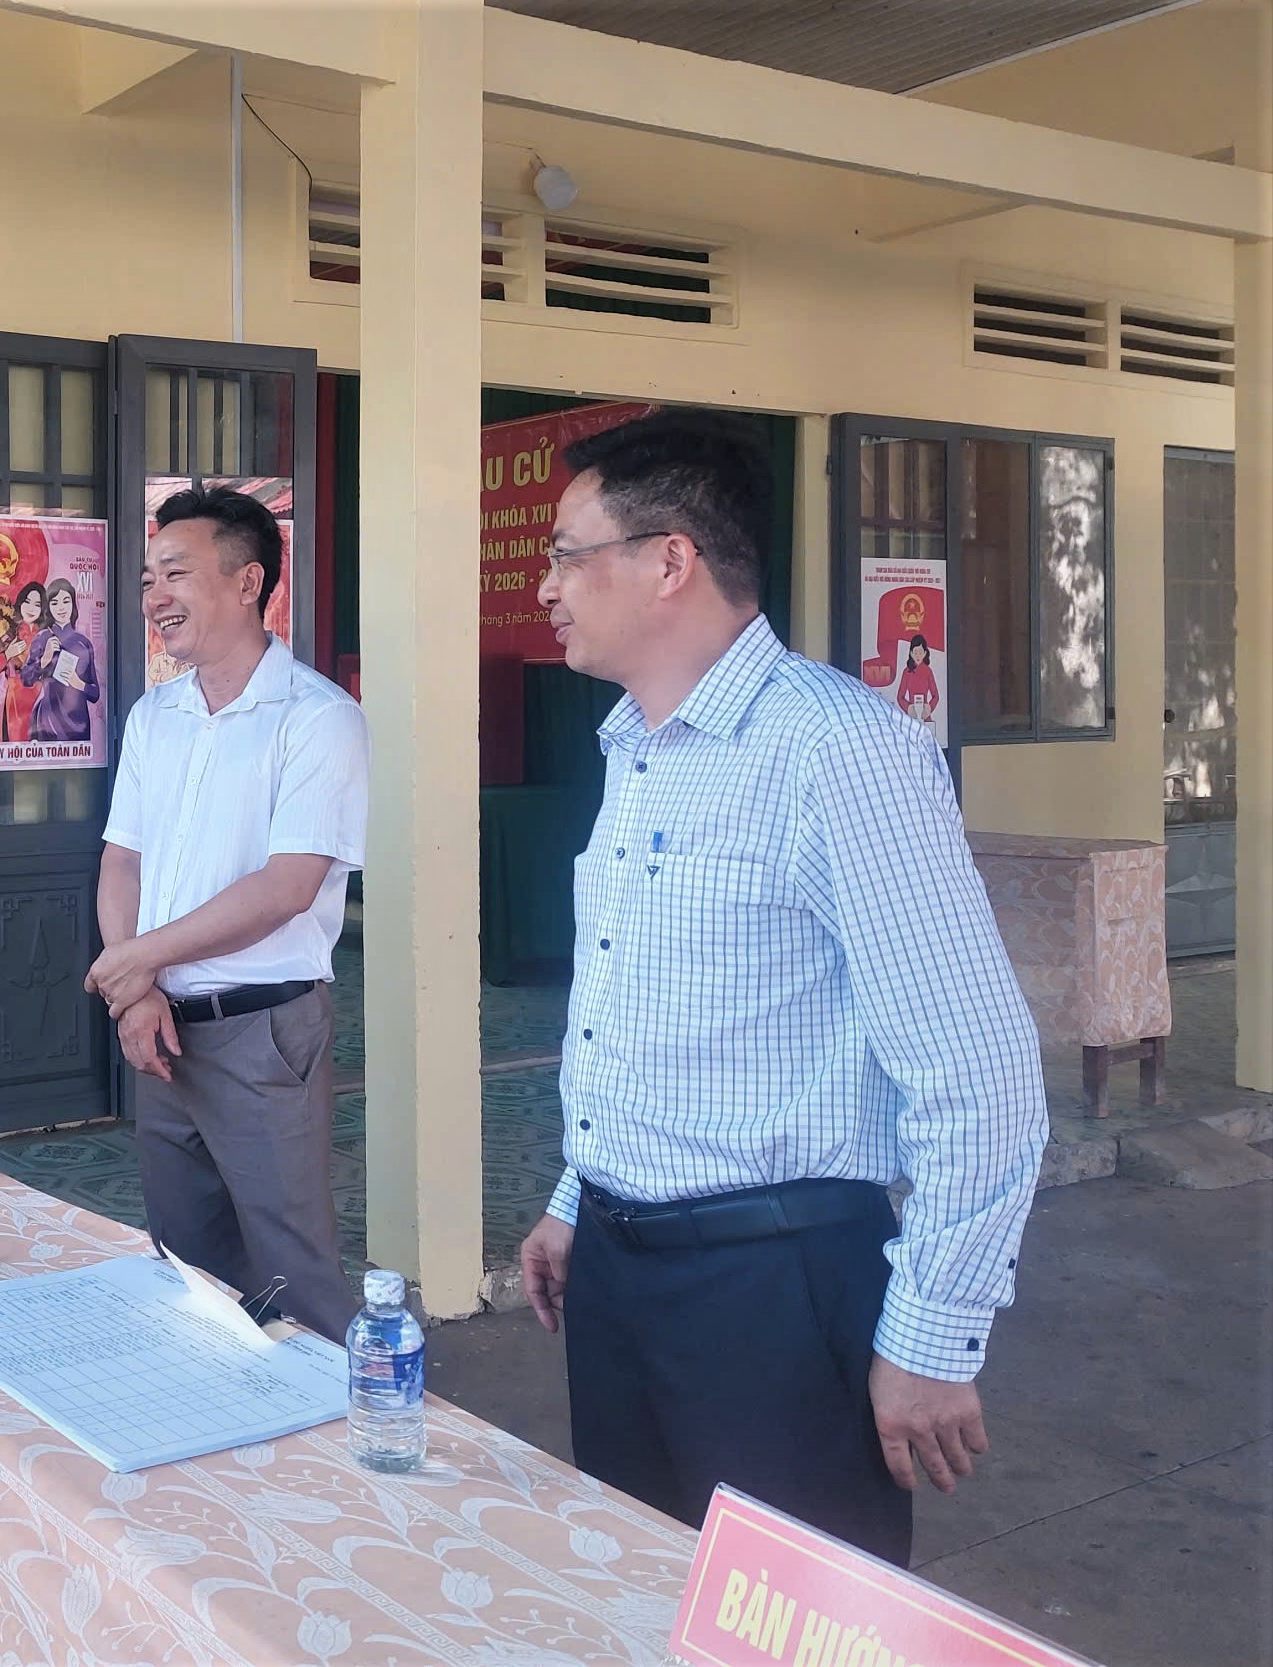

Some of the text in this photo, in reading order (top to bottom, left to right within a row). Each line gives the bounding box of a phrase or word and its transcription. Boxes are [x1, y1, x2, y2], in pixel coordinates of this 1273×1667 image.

[513, 436, 555, 487] CỬ
[491, 504, 528, 529] KHÓA
[531, 502, 552, 525] XVI
[509, 535, 536, 559] DÂN
[76, 571, 94, 592] XVI
[494, 571, 526, 592] 2026
[505, 612, 511, 624] 3
[512, 611, 532, 624] năm
[533, 610, 550, 622] 202
[7, 745, 23, 762] HỘI
[25, 743, 44, 758] CỦA
[46, 744, 70, 758] TOÀN
[72, 743, 91, 757] DÂN
[715, 1568, 797, 1661] BÀN
